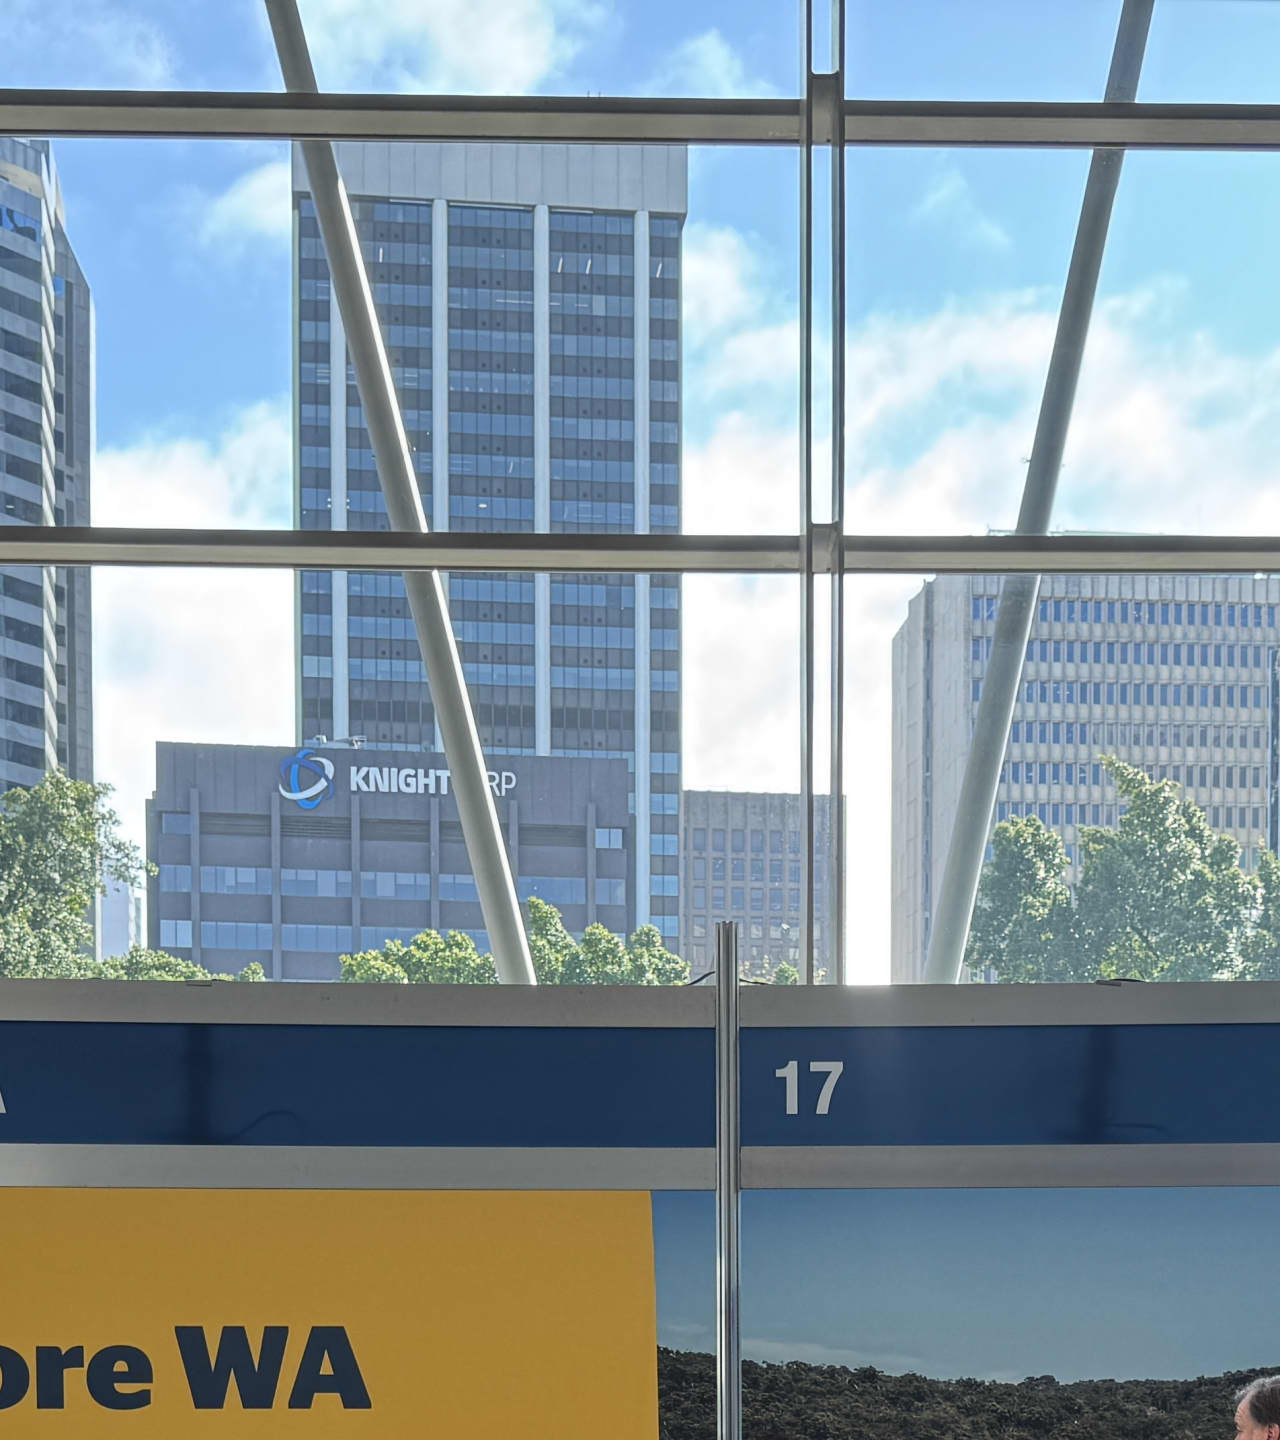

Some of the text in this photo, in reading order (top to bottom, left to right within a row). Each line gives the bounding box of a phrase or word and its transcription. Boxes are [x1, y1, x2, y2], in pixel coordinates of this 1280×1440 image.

[349, 765, 516, 797] KNIGHTRP
[775, 1060, 844, 1115] 17
[174, 1325, 372, 1410] WA
